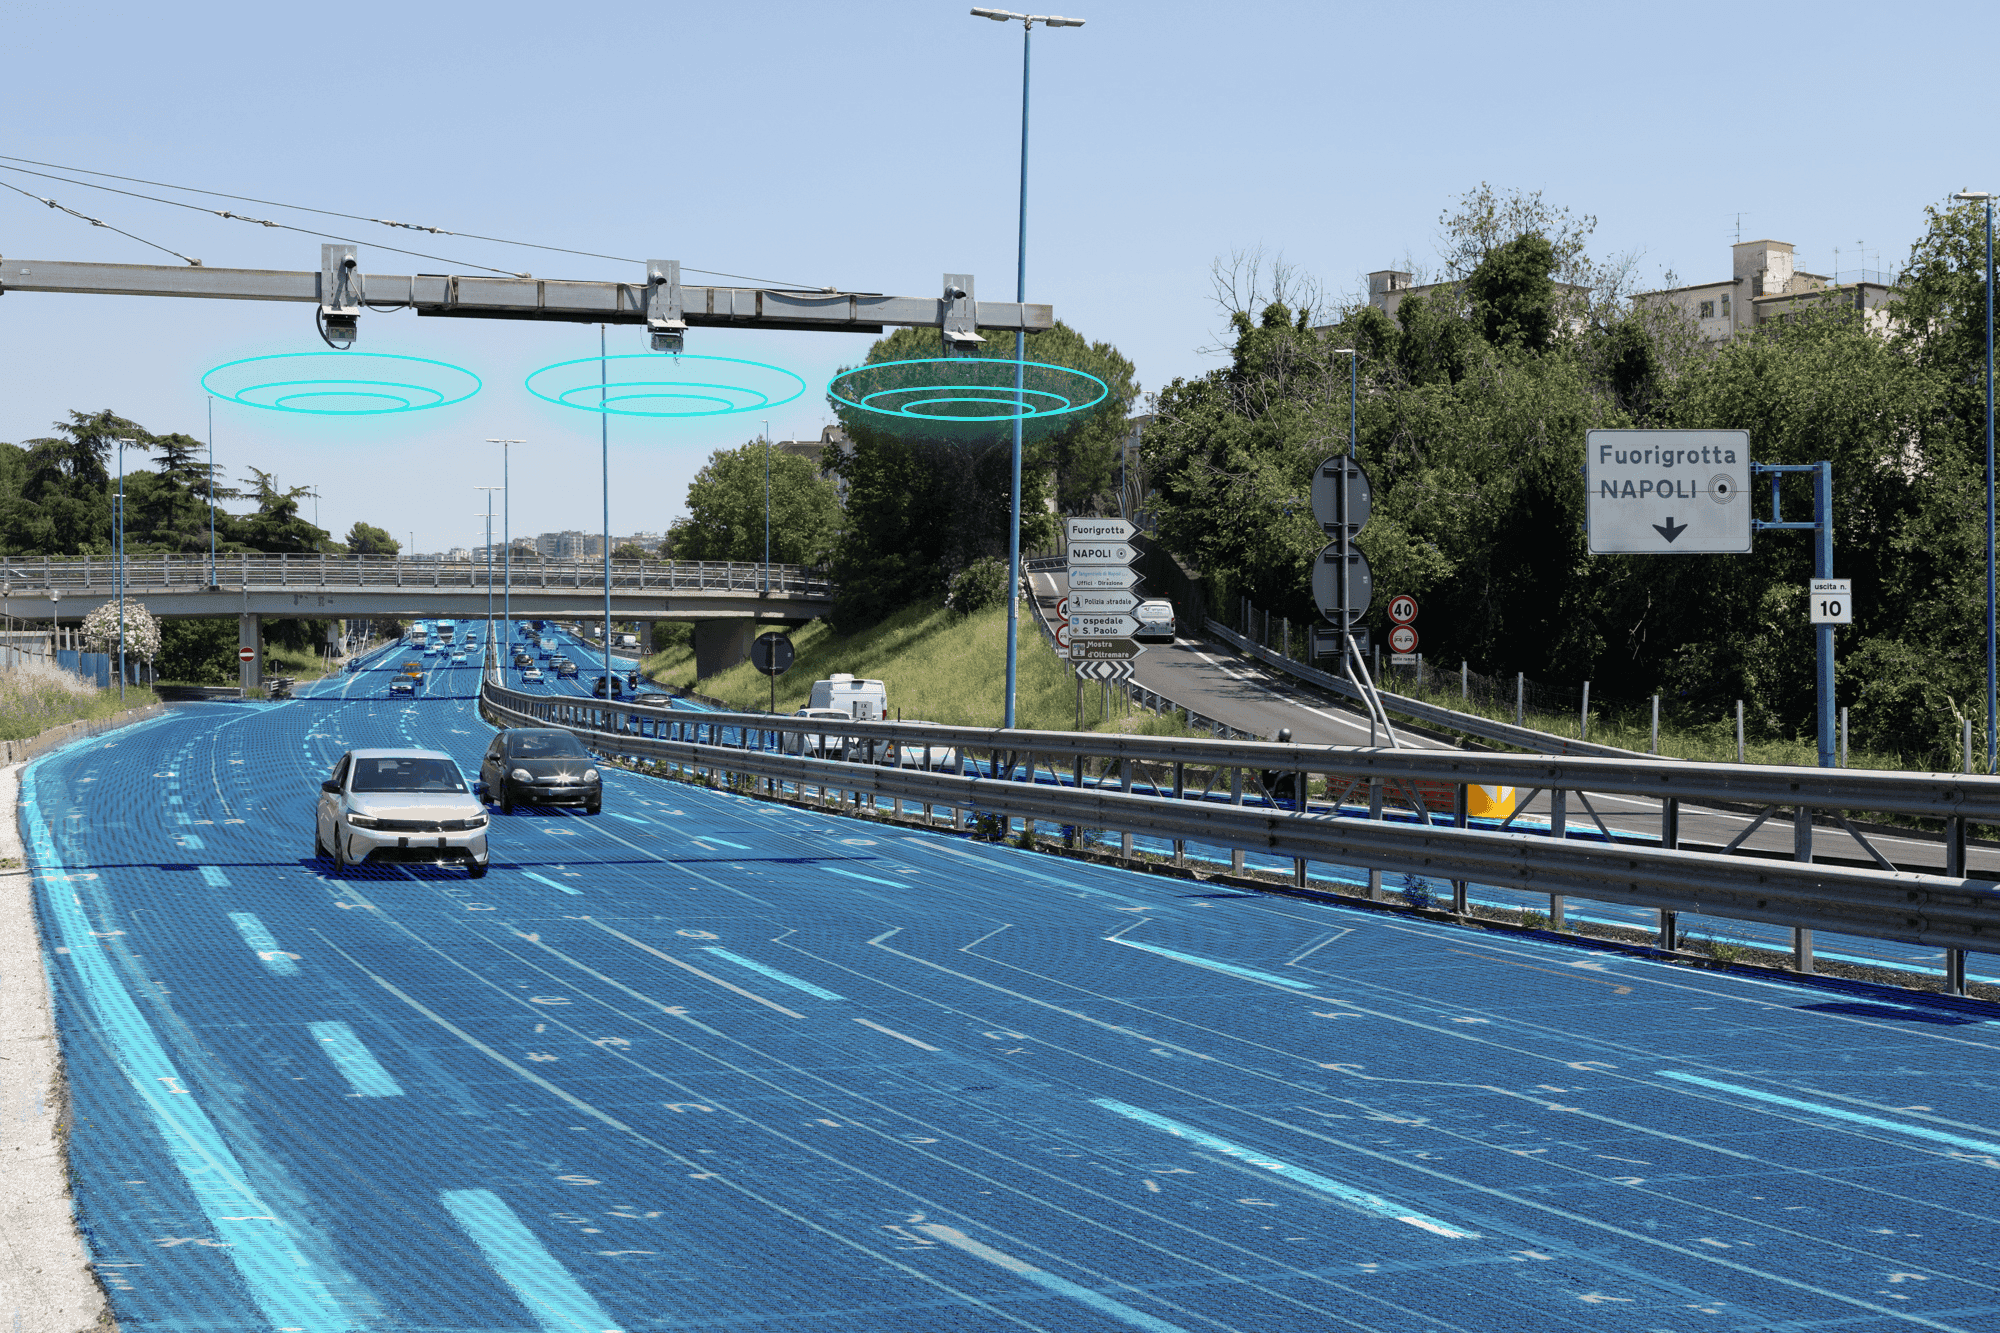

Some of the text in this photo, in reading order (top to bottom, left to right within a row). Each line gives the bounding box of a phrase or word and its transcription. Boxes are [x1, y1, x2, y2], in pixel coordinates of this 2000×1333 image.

[1599, 445, 1736, 468] Fuorigrotta
[1600, 479, 1696, 499] NAPOLI
[1072, 525, 1125, 535] Fuorigrotta
[1073, 549, 1112, 558] NAPOLI
[1814, 582, 1837, 590] uscita
[1394, 603, 1412, 616] 40
[1820, 600, 1842, 617] 10
[1083, 617, 1123, 625] ospedale
[1082, 626, 1118, 635] S. Paolo
[1086, 640, 1113, 649] Mostra
[1087, 650, 1130, 658] d'Oltremare
